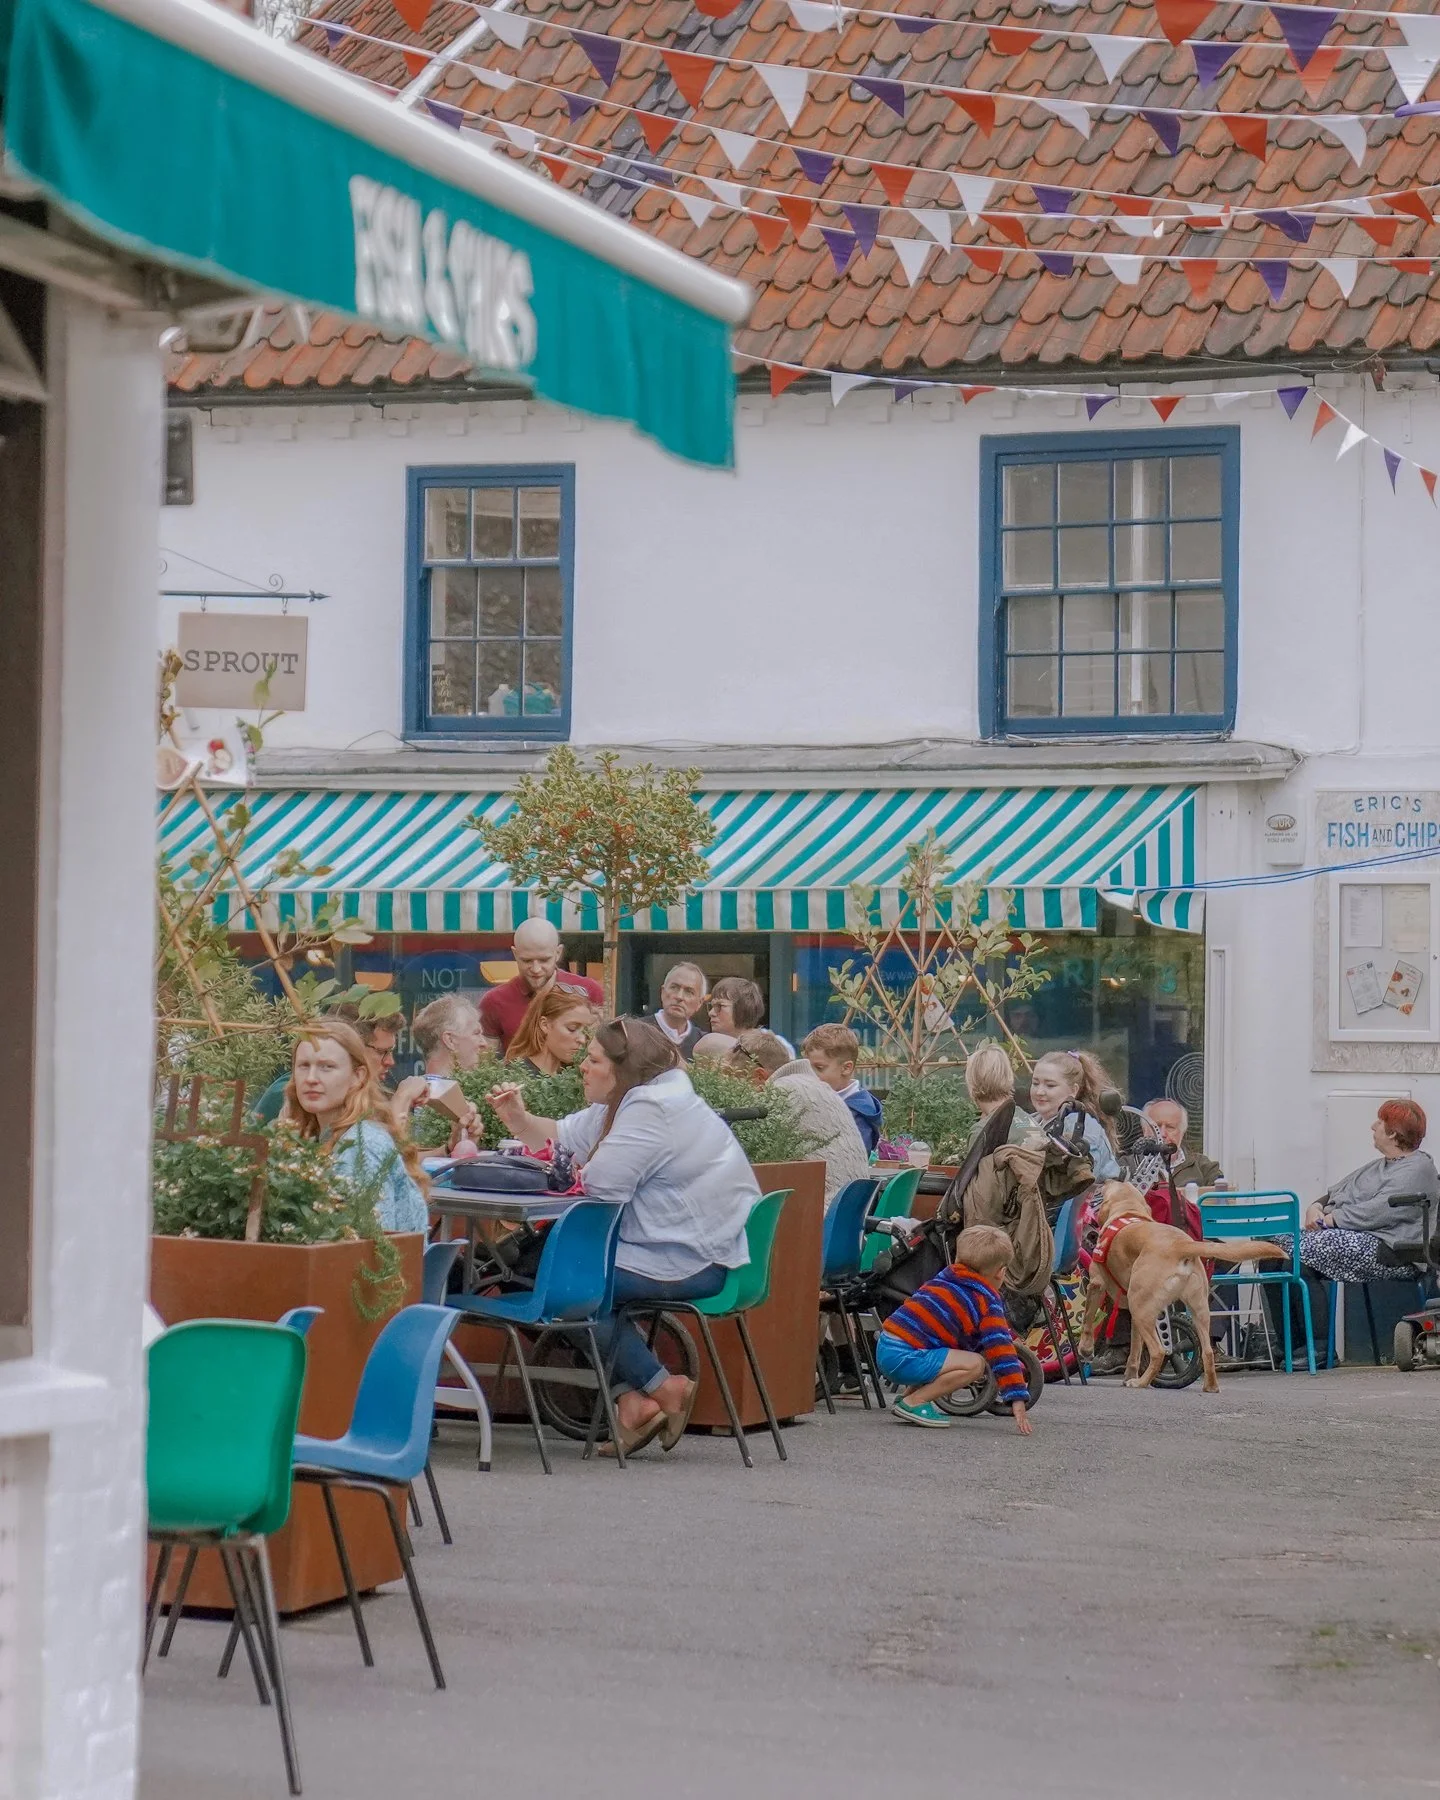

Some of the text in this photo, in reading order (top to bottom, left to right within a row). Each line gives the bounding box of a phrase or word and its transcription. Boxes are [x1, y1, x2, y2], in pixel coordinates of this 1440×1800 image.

[183, 649, 299, 675] SPROUT
[1354, 795, 1422, 813] ERIC'S
[1327, 822, 1440, 848] FISH AND CHIP
[421, 967, 468, 989] NOT
